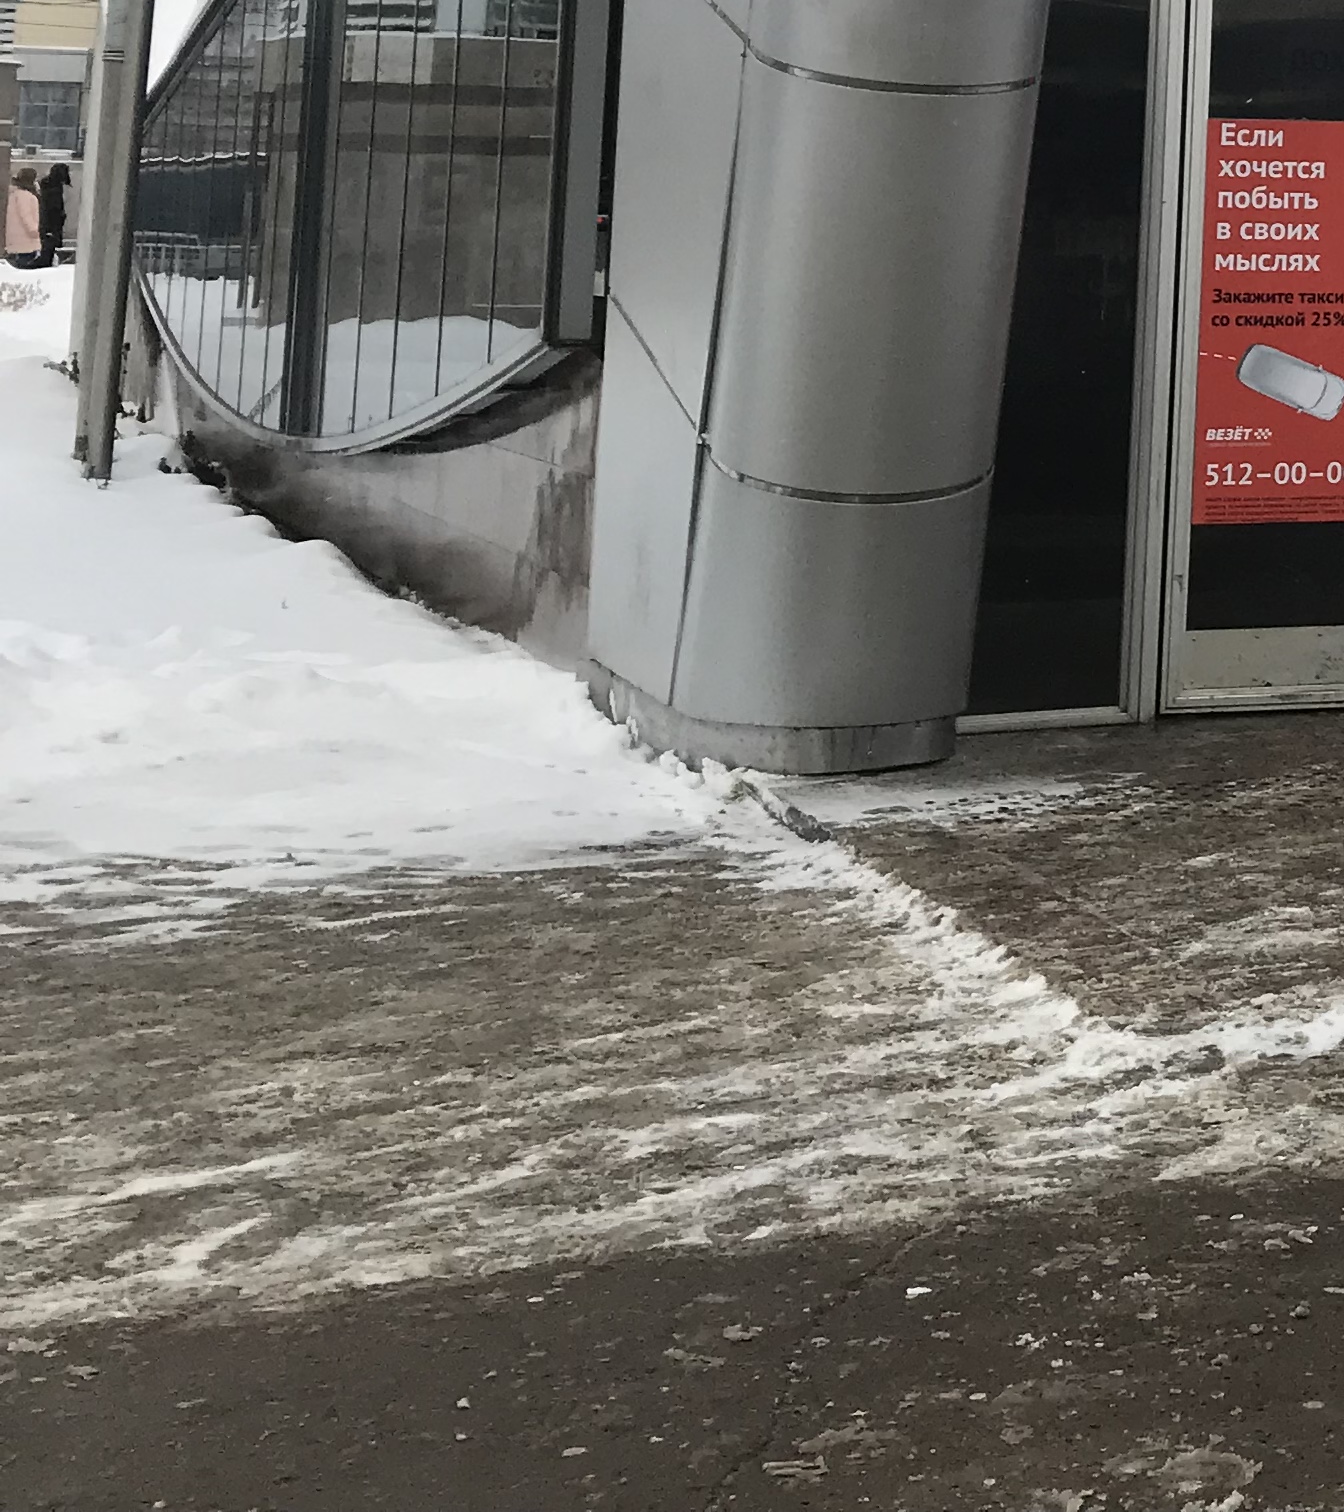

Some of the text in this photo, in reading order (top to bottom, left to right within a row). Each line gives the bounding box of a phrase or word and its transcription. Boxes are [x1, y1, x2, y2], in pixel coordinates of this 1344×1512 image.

[1221, 123, 1283, 146] Если
[1219, 160, 1325, 178] хочется
[1218, 186, 1318, 209] побыть
[1217, 223, 1319, 240] в своих
[1215, 254, 1320, 271] мыслях
[1212, 289, 1344, 304] Закажите такси
[1211, 315, 1230, 327] со
[1235, 312, 1305, 328] скидкой
[1205, 425, 1252, 442] ВЕЗЁТ
